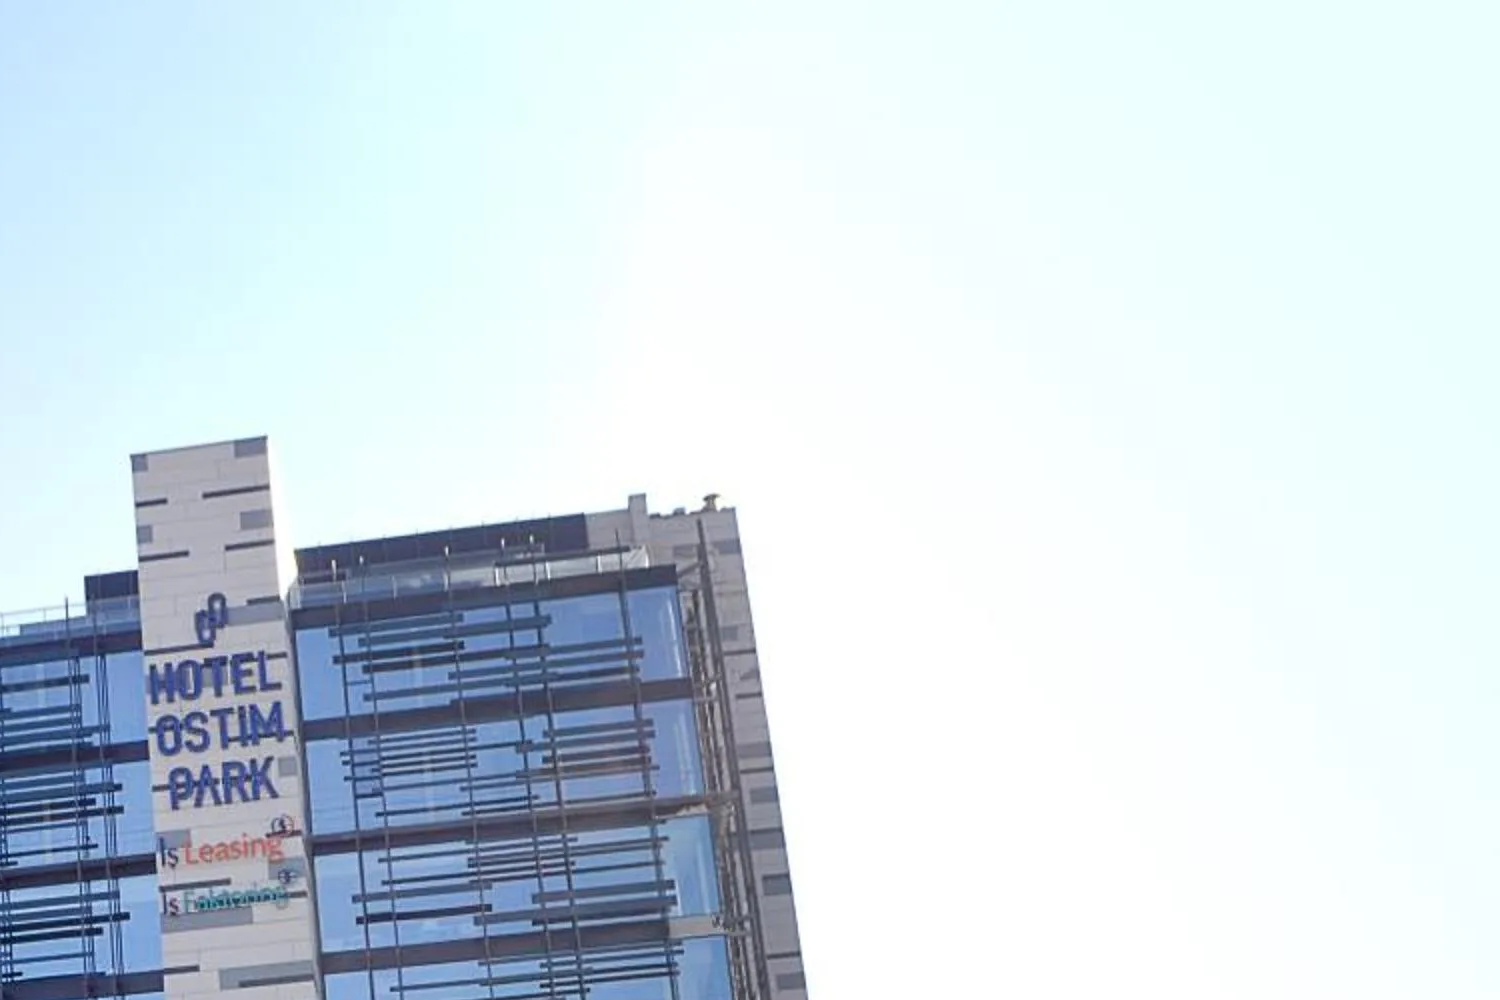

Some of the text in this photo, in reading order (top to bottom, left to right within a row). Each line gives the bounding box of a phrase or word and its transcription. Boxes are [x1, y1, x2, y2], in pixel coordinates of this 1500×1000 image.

[148, 649, 283, 704] HOTEL
[168, 755, 281, 811] PARK
[184, 832, 285, 865] Leasing
